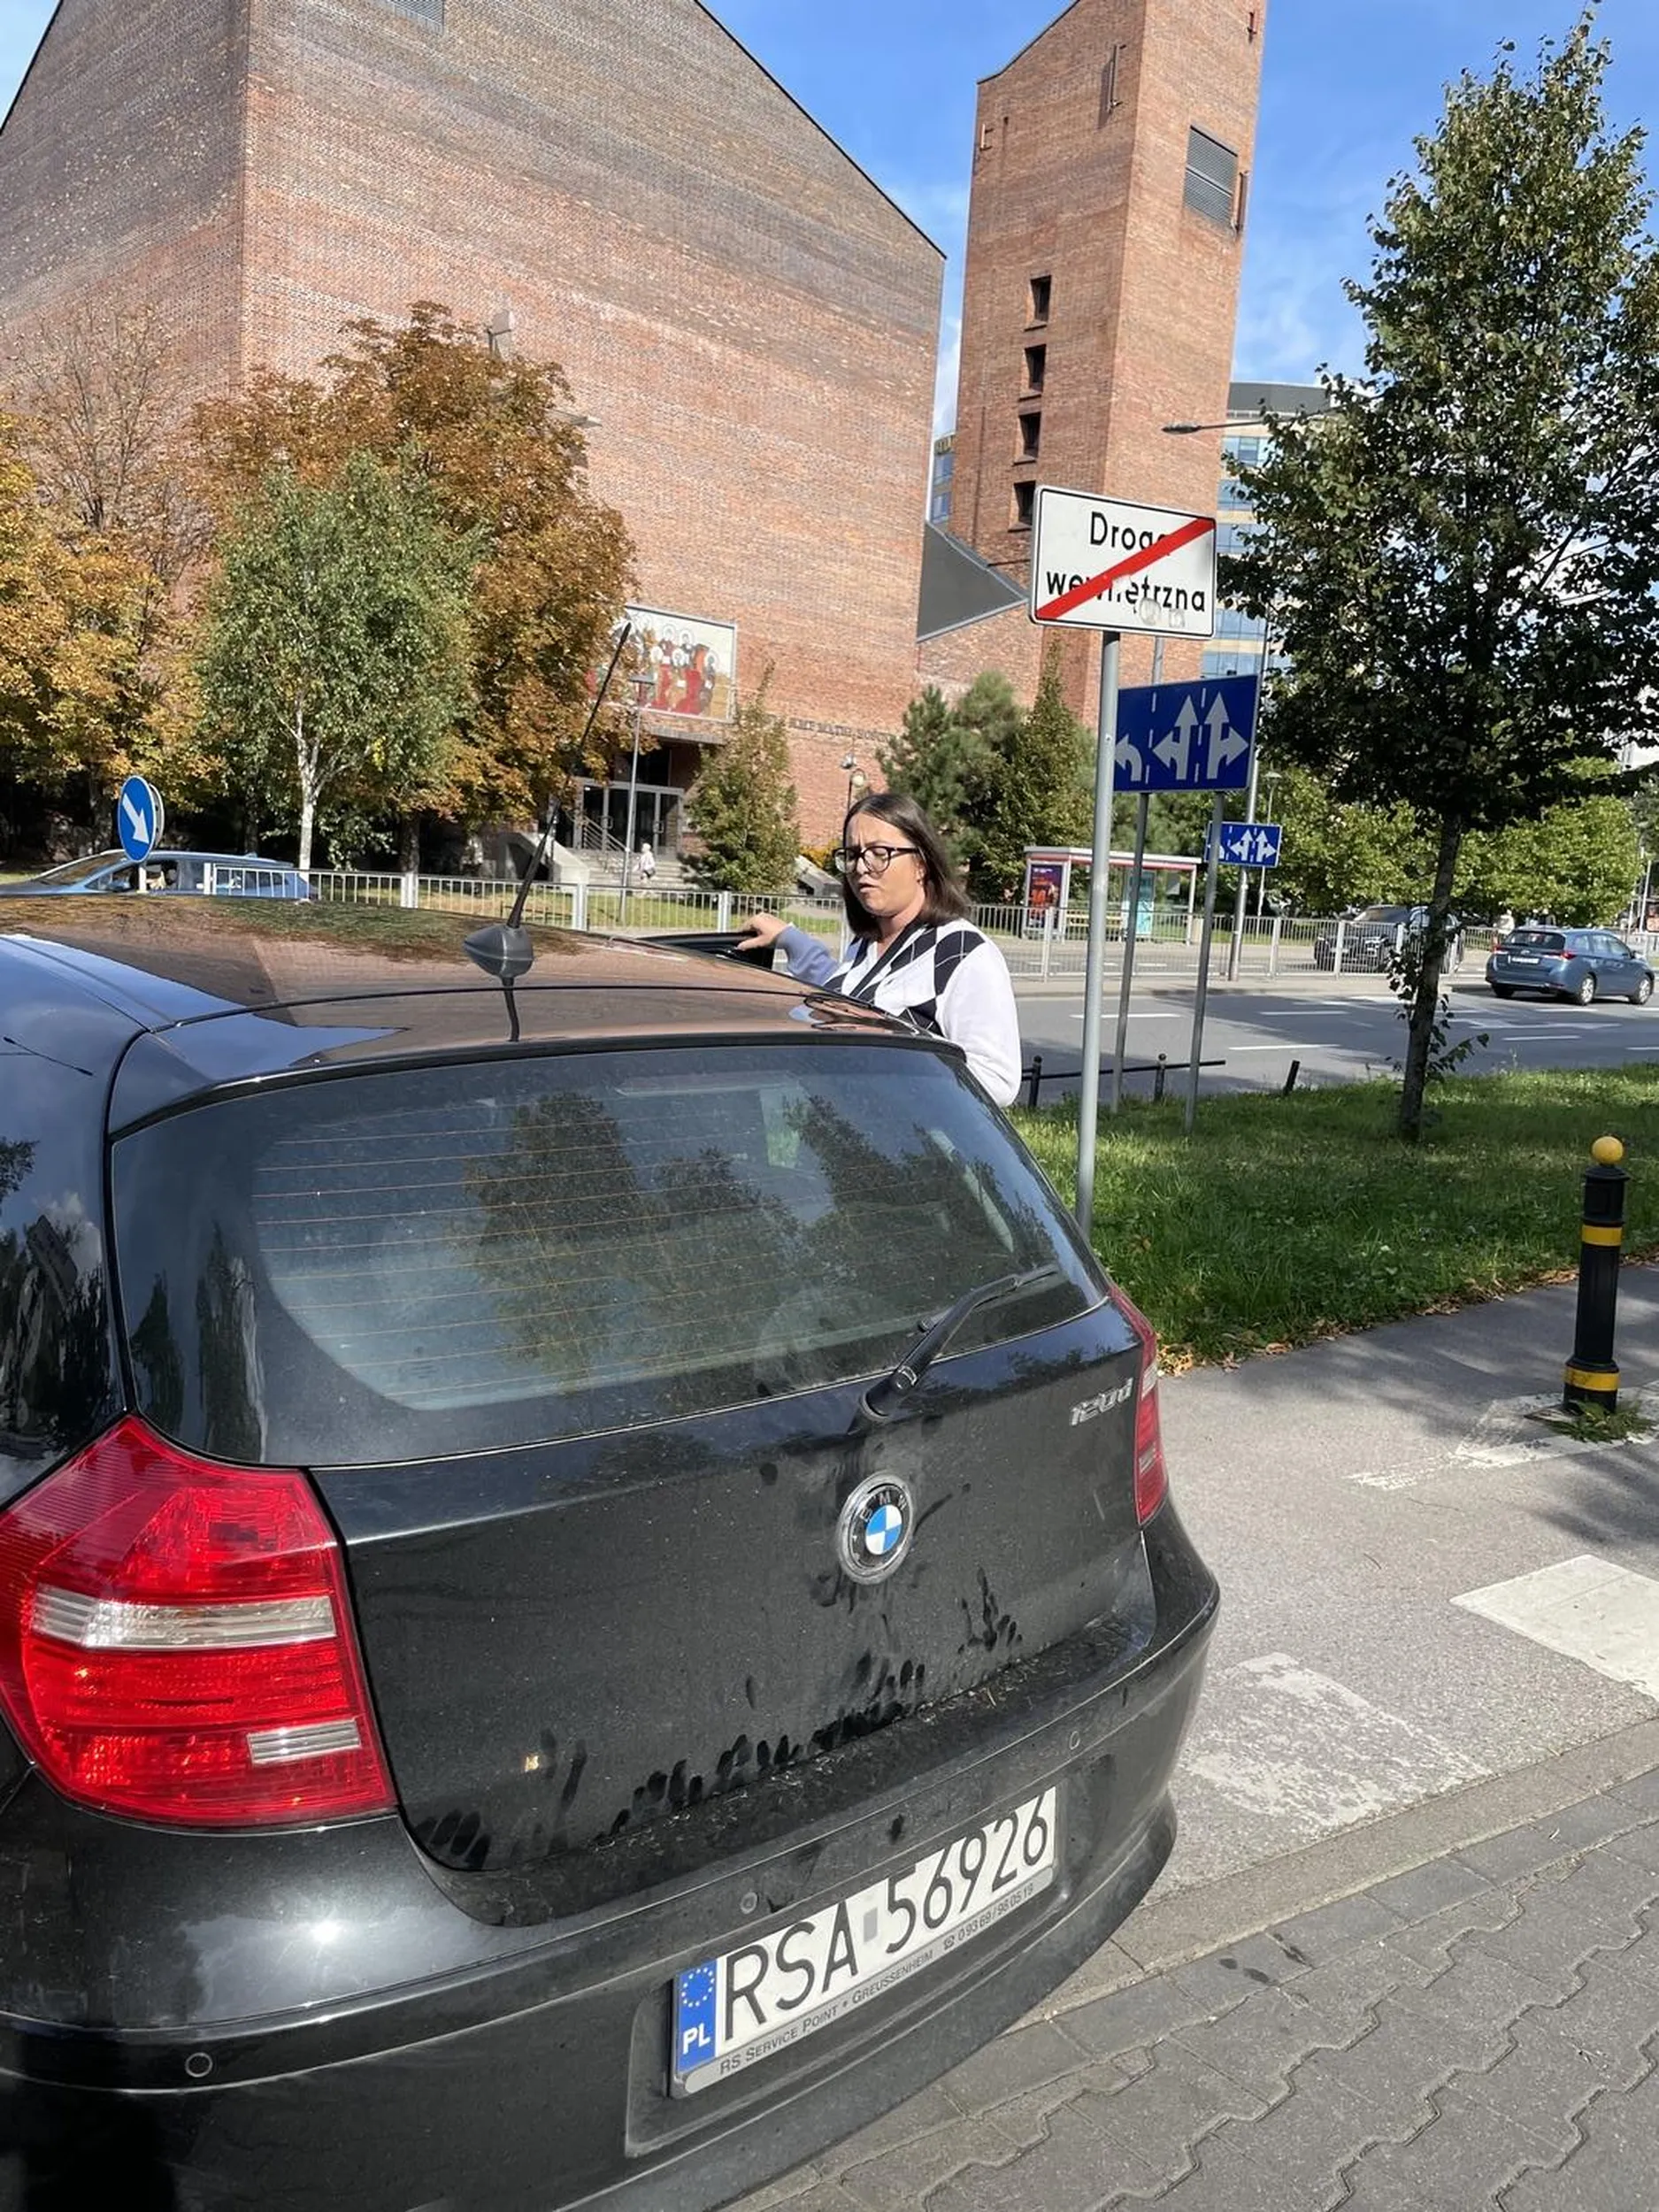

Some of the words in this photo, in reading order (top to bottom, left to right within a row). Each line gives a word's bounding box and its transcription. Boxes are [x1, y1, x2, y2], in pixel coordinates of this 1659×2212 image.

[1046, 571, 1206, 613] weętrzna
[859, 1490, 908, 1523] BMW
[725, 1901, 858, 2041] RSA
[886, 1793, 1048, 1954] 56926
[682, 2023, 711, 2055] PL
[719, 2055, 741, 2075] RS
